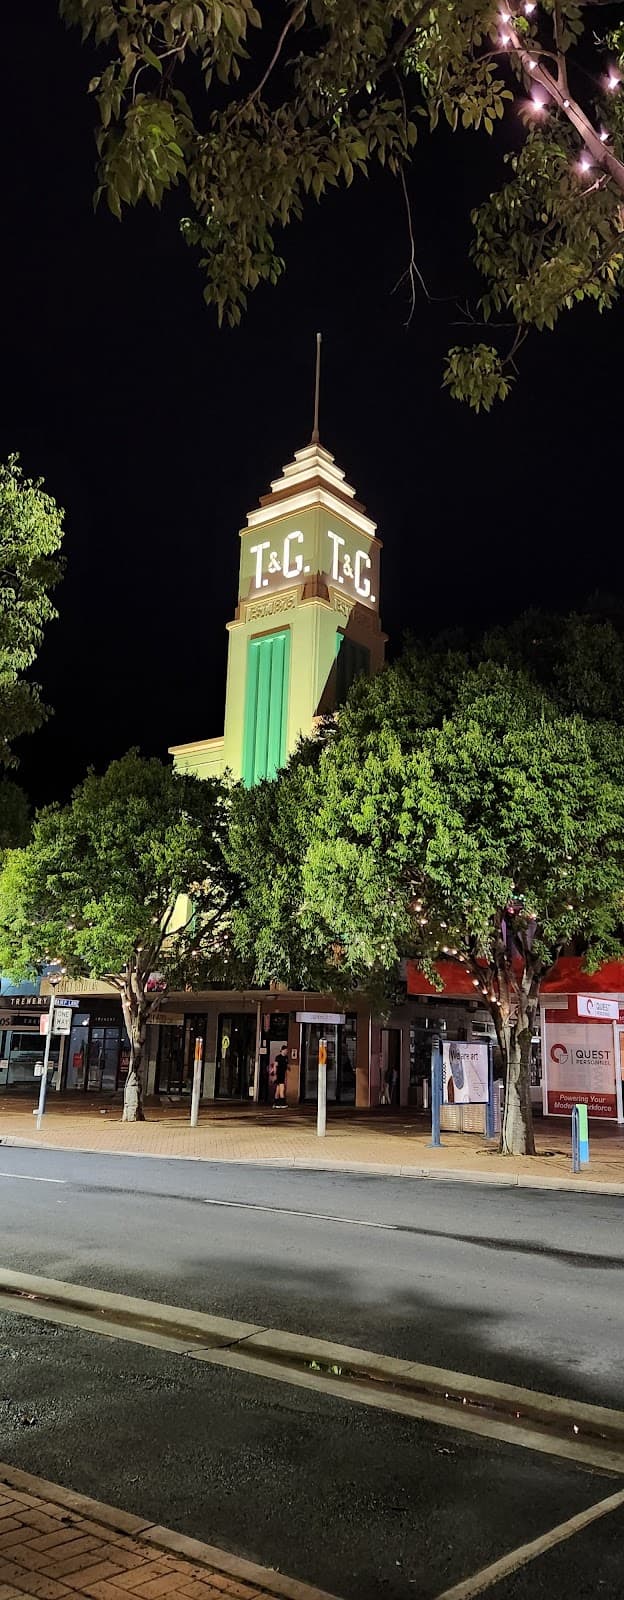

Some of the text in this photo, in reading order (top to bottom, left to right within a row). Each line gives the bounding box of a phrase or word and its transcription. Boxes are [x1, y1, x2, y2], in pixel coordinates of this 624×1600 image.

[11, 997, 48, 1006] TRENERY
[576, 1049, 610, 1060] QUEST
[559, 1094, 606, 1103] Powering Your
[554, 1101, 574, 1109] Moder
